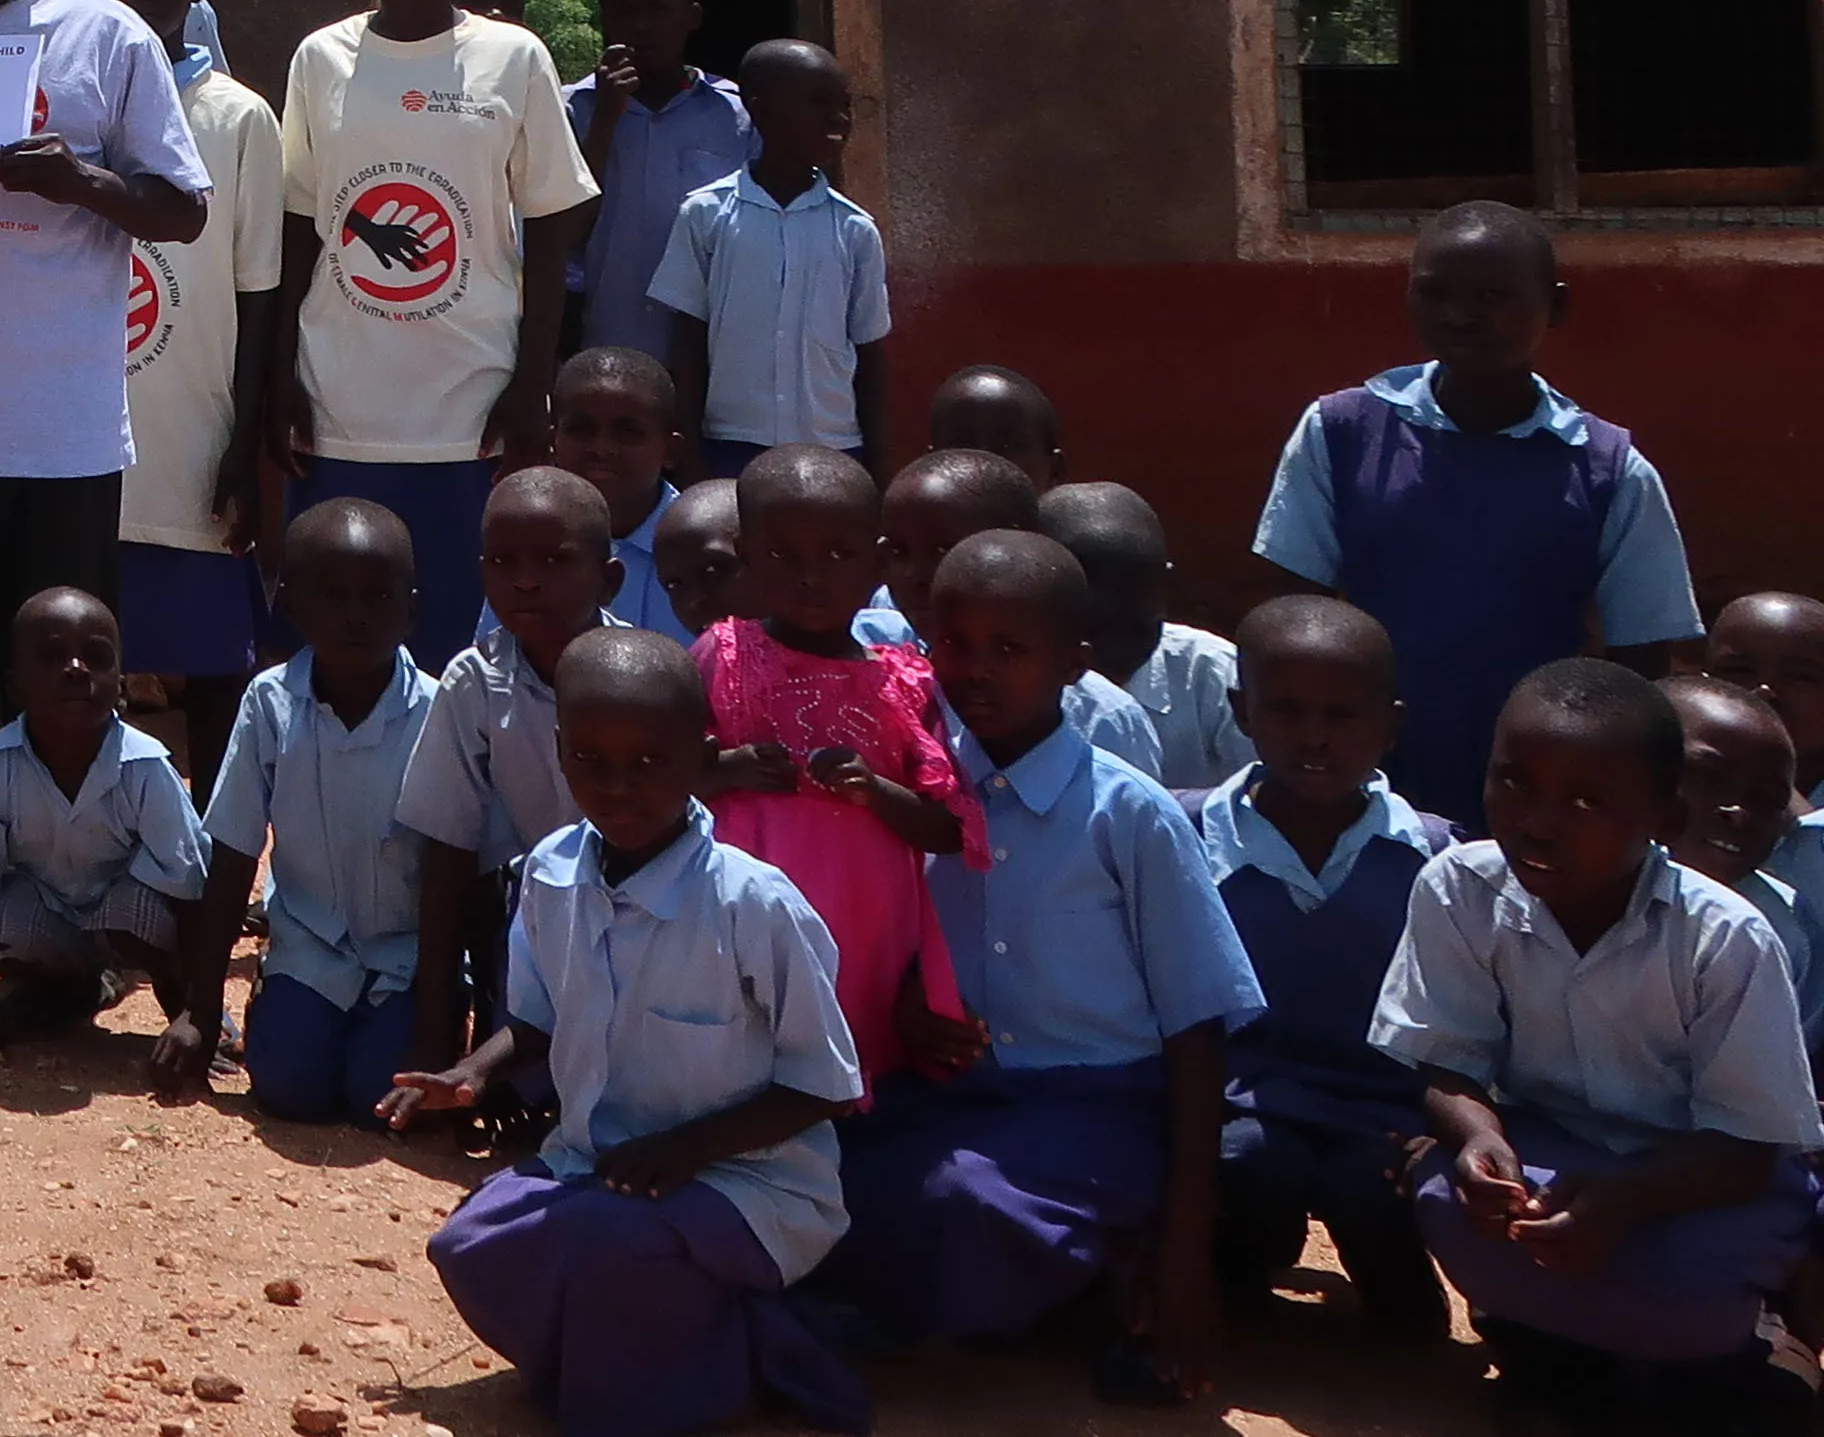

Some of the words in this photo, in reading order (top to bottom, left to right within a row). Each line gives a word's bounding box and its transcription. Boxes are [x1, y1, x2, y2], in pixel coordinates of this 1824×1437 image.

[429, 90, 474, 103] Ayuda
[427, 104, 444, 113] en
[349, 164, 387, 188] CLOSER
[389, 162, 402, 173] TO
[406, 163, 426, 177] THE
[428, 171, 474, 239] ERRADICATION
[393, 299, 453, 322] MUTILATION
[143, 352, 156, 366] IN
